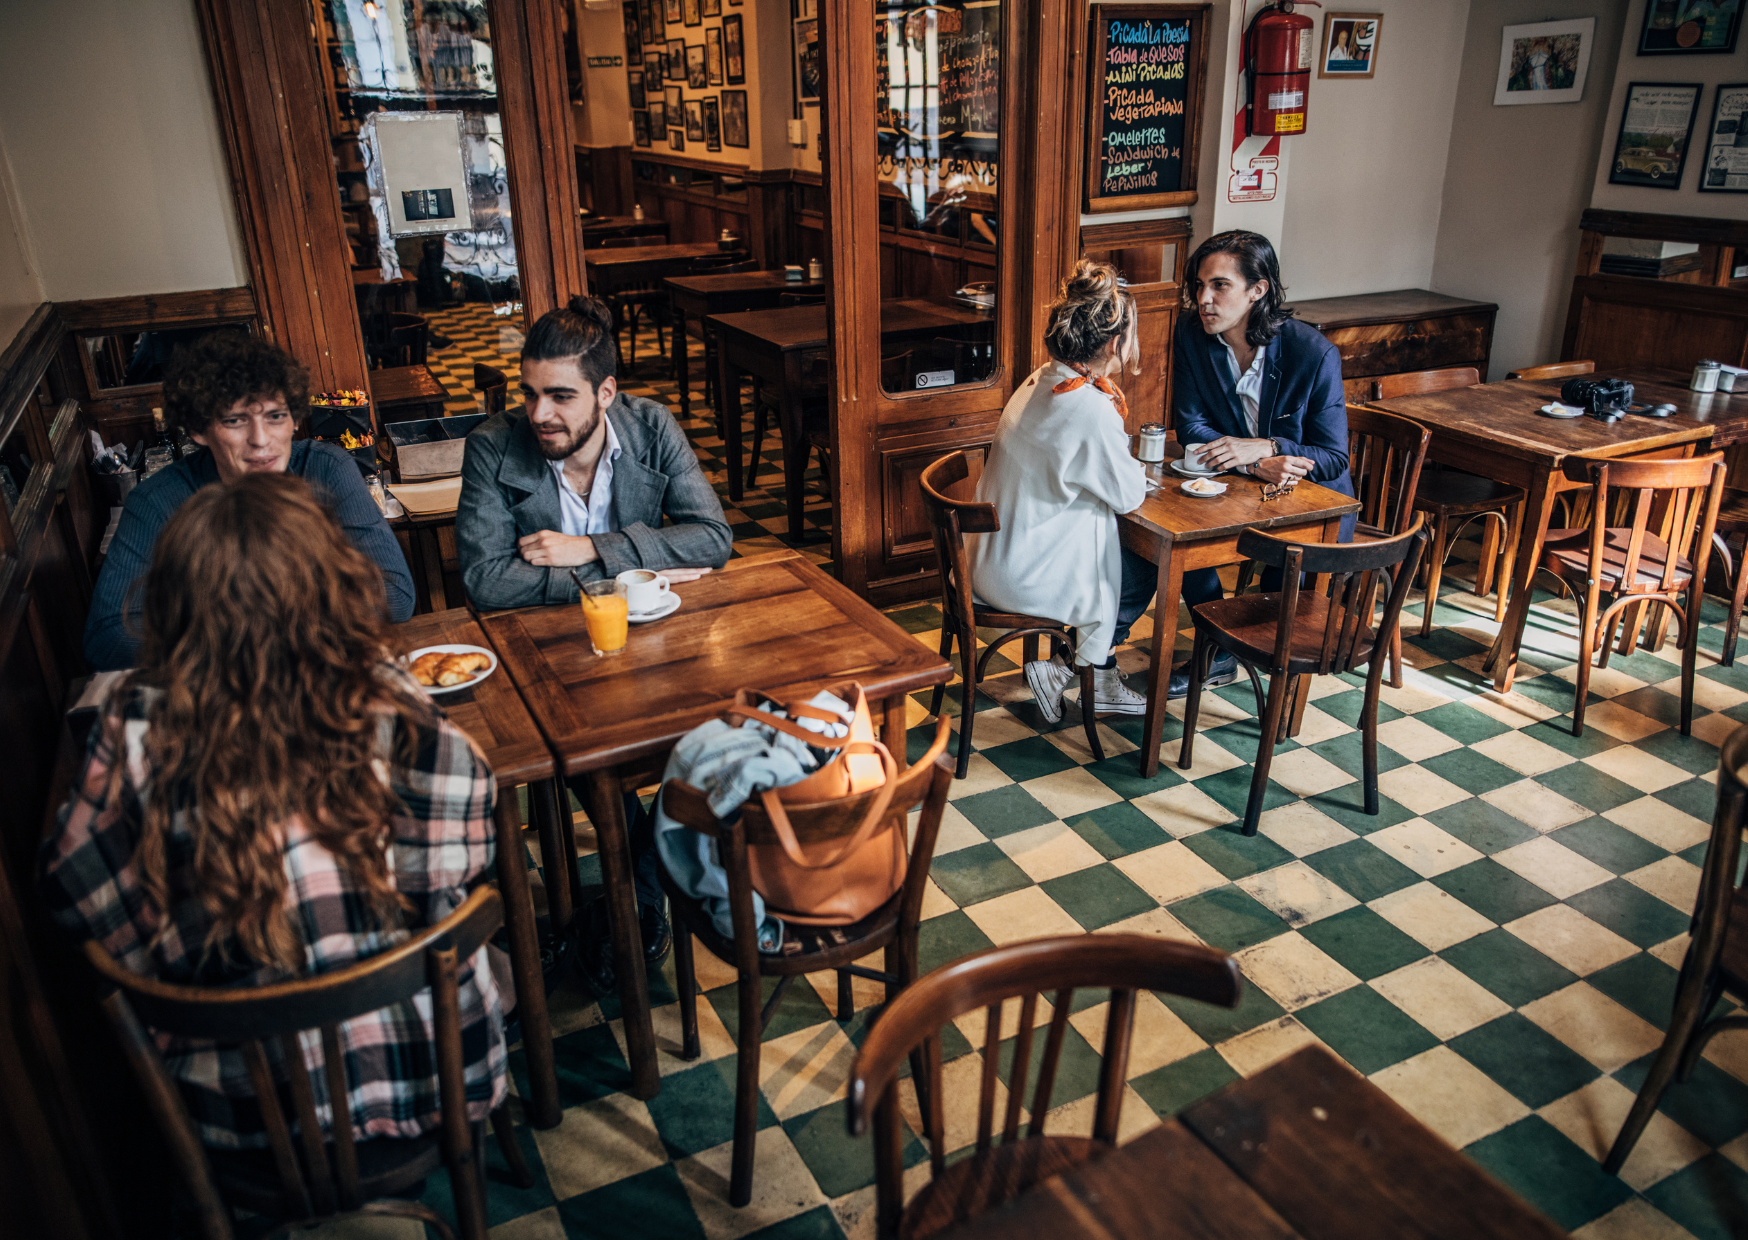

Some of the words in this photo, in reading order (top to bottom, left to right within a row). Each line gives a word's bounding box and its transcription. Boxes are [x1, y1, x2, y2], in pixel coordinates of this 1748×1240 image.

[1139, 48, 1148, 62] de
[1110, 96, 1183, 124] vegetariana
[1107, 162, 1145, 178] Leber
[1102, 170, 1158, 192] Pepinillos
